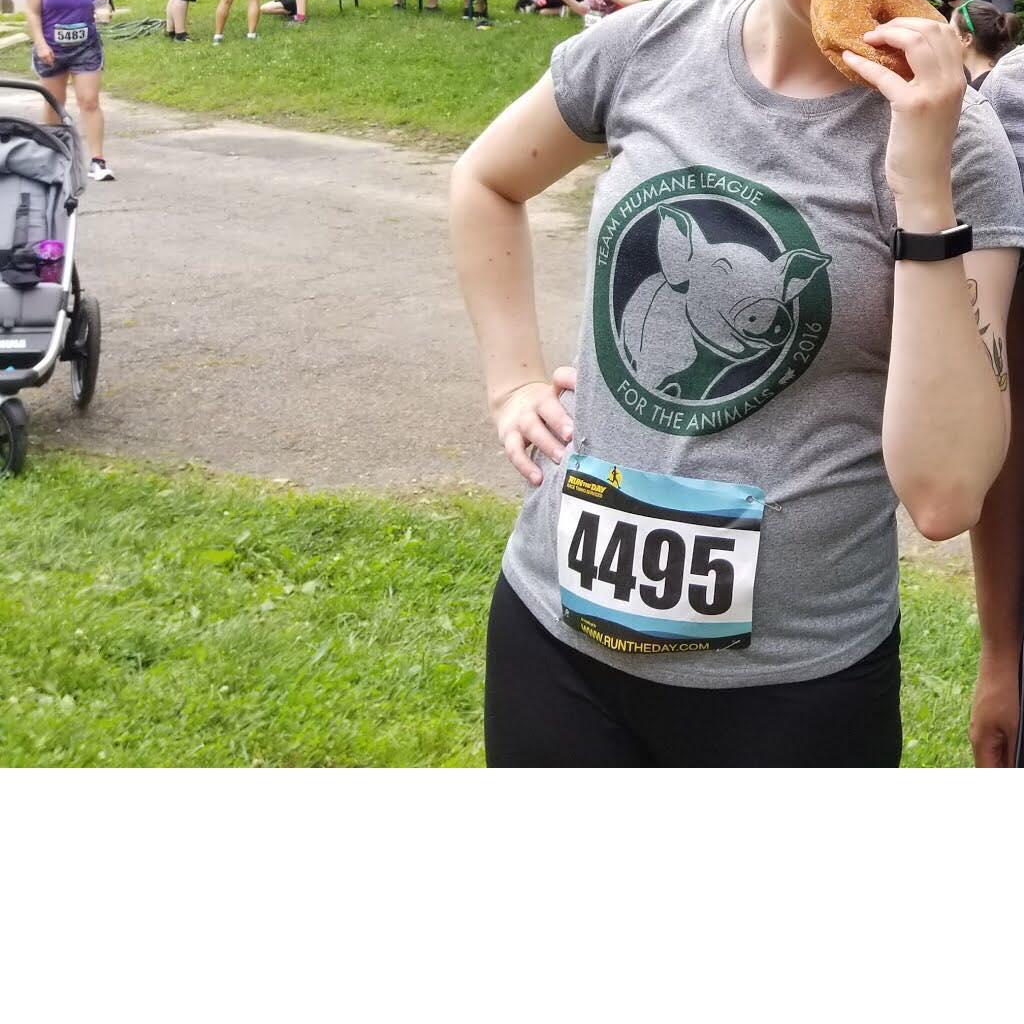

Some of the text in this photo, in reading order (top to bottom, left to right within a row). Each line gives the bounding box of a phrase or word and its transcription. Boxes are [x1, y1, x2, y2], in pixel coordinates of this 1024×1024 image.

[57, 30, 86, 41] 5483
[598, 173, 764, 266] TEAM HUMANE LEAGUE
[616, 322, 823, 431] FOR THE ANIMALS 2016
[567, 510, 736, 616] 4495
[580, 622, 710, 653] WWW.RUNTHEDAY.COM
